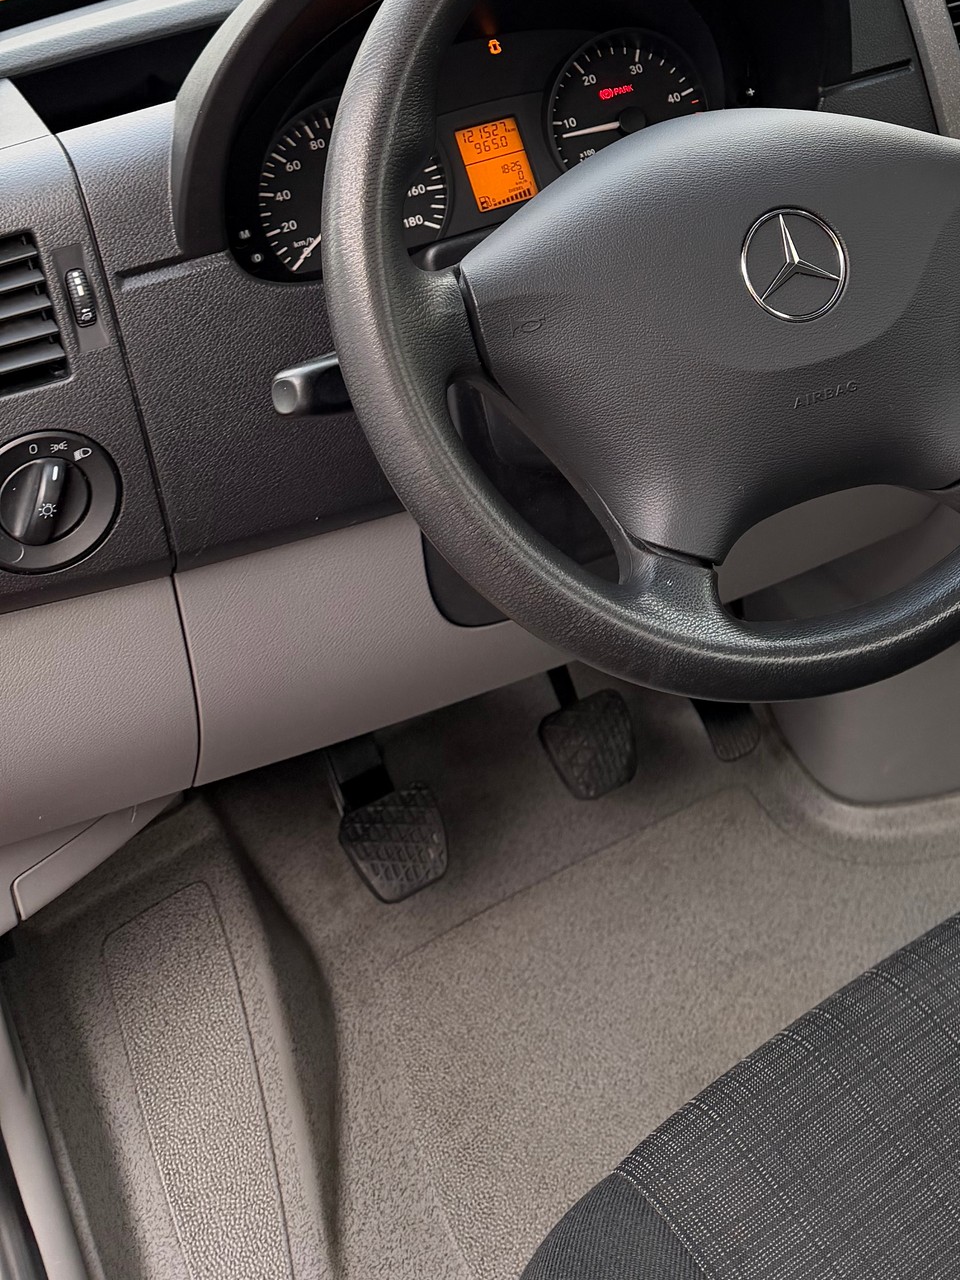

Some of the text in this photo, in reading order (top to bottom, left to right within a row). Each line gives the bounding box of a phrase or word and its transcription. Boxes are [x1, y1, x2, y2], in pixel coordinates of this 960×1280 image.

[629, 63, 643, 75] 30
[582, 74, 597, 86] 20
[613, 84, 634, 96] PARK
[667, 92, 681, 104] 40
[563, 117, 577, 129] 10
[462, 122, 508, 144] 121527
[309, 138, 326, 151] 80
[474, 135, 508, 155] 965.0
[285, 159, 301, 173] 60
[275, 189, 291, 203] 40
[281, 219, 298, 233] 20
[403, 214, 424, 229] 180
[239, 229, 251, 239] M
[293, 236, 315, 248] km/h
[793, 381, 858, 409] AIRBAG
